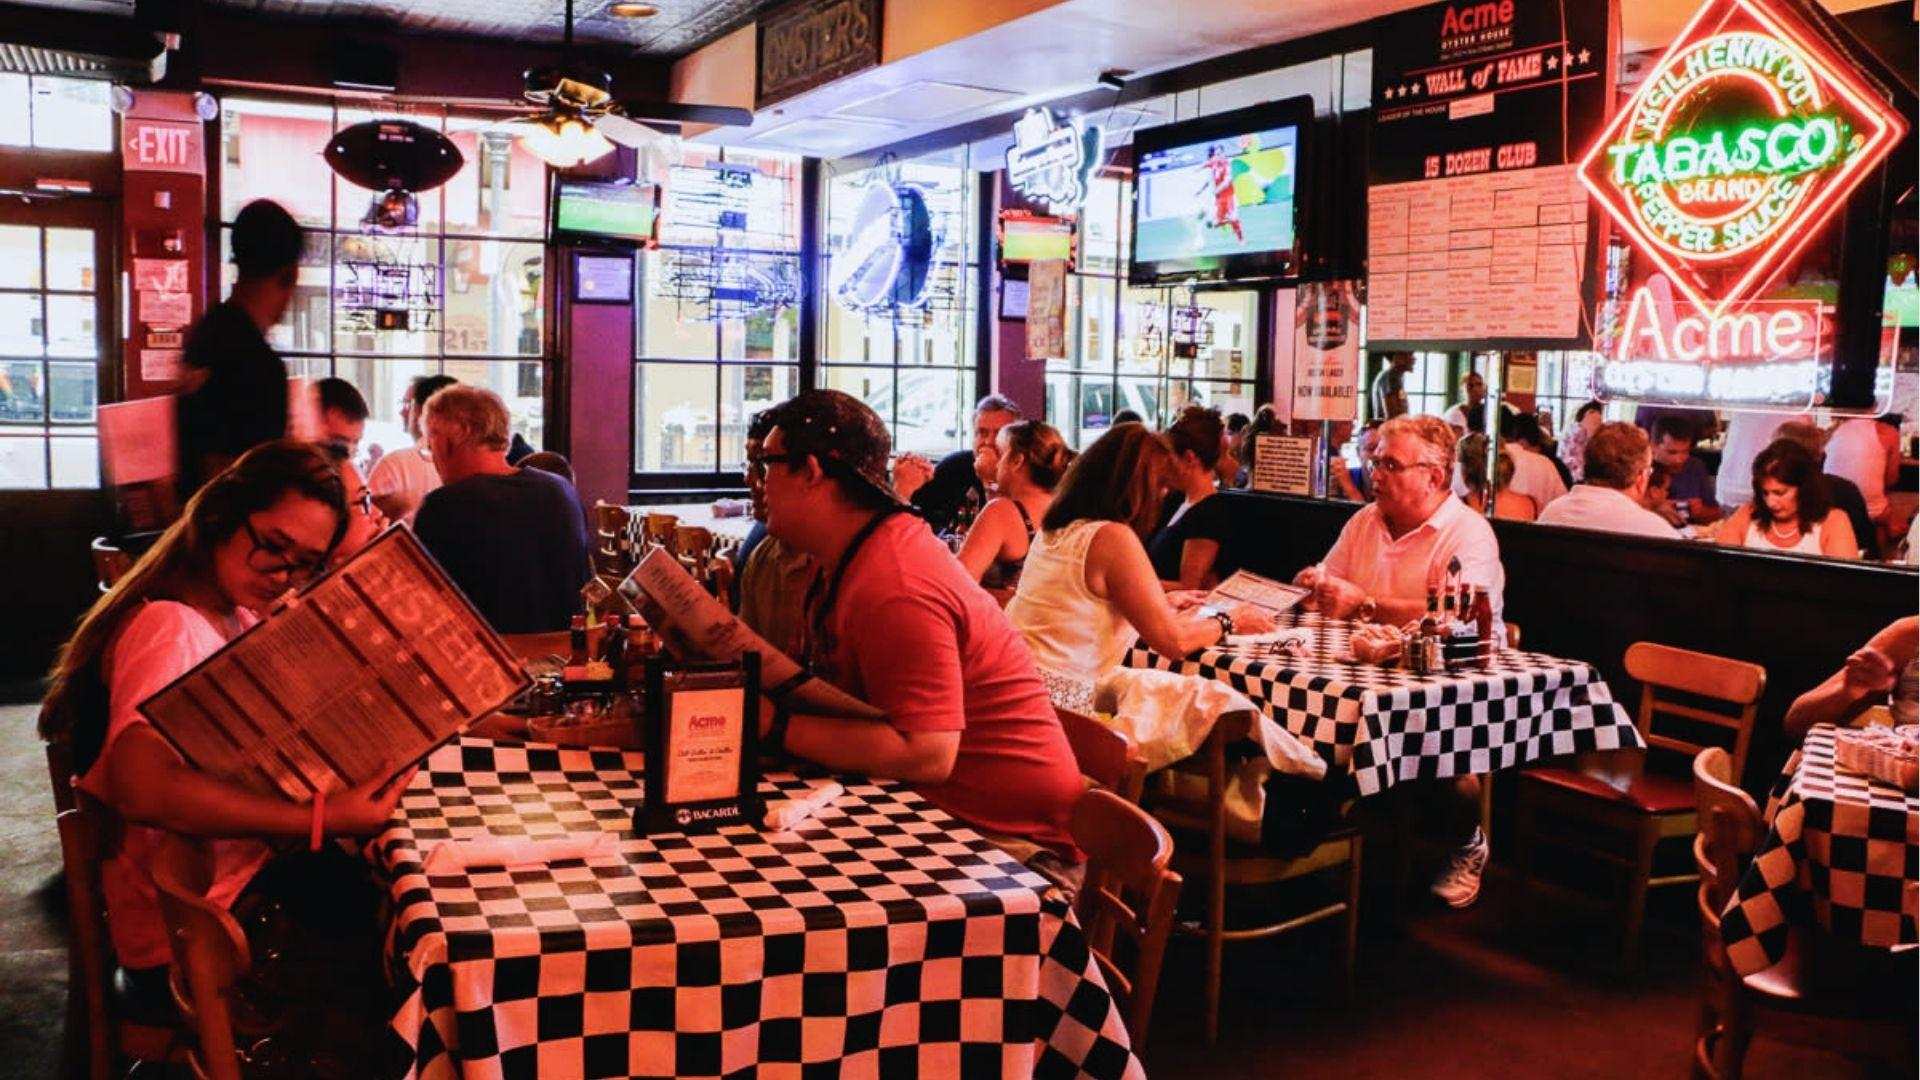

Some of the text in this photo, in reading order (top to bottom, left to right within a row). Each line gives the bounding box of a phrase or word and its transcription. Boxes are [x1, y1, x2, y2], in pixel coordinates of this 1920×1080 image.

[1440, 0, 1516, 38] Acme
[1425, 53, 1543, 96] WALL of FAME
[138, 125, 191, 165] EXIT
[1425, 140, 1538, 179] 15 DOZEN CLUB
[1608, 118, 1837, 186] TABASCO
[1678, 178, 1762, 204] BRAND
[1637, 177, 1800, 250] PEPPER SAUCE
[1617, 286, 1806, 361] Acme
[688, 715, 727, 732] Acme
